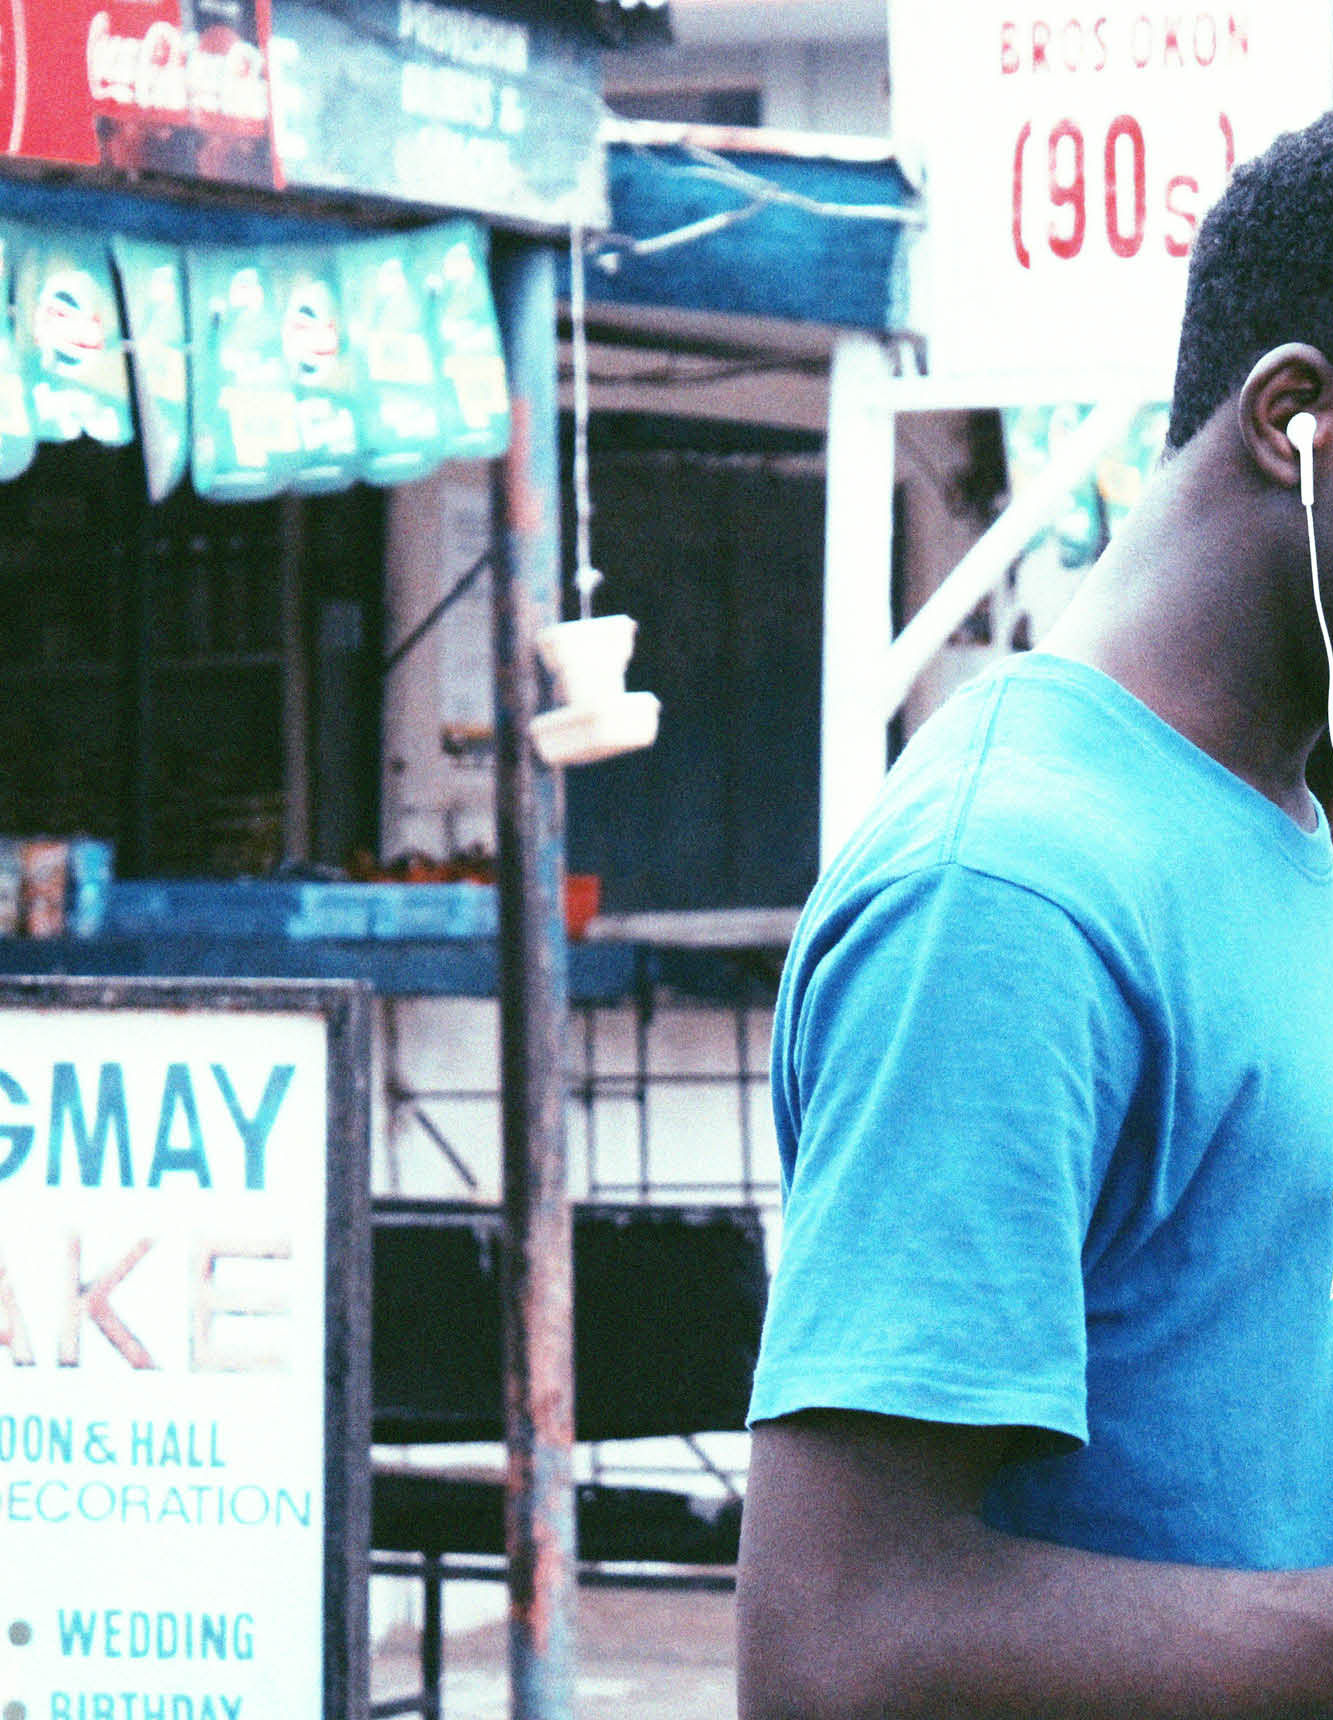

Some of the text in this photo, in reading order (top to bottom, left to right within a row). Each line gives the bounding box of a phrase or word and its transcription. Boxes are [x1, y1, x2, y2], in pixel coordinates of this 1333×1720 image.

[1001, 17, 1107, 74] BROS
[84, 1421, 118, 1465] &
[131, 1420, 226, 1468] HALL
[0, 1480, 311, 1528] ECORATION
[58, 1608, 255, 1661] WEDDING
